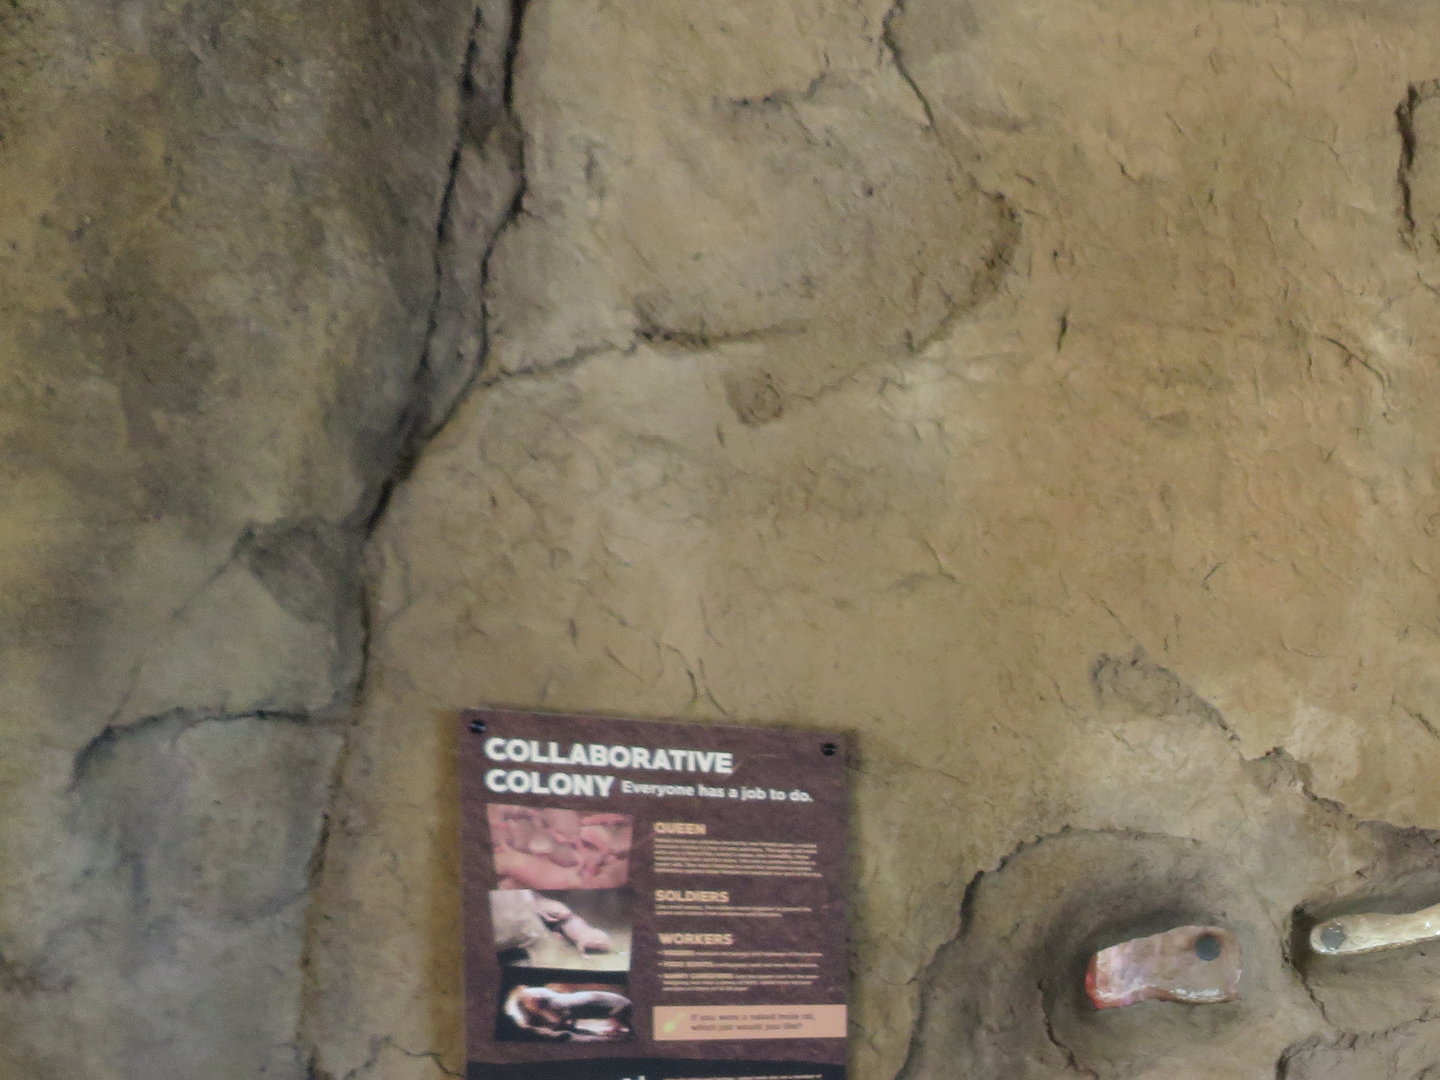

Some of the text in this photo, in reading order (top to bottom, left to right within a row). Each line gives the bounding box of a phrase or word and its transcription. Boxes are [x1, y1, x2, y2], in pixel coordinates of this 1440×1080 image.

[484, 737, 733, 774] COLLABORATIVE
[484, 769, 814, 802] COLONY Everyone has a job to do.
[654, 822, 706, 835] QUEEN
[655, 889, 730, 903] SOLDIERS
[657, 933, 734, 945] WORKERS
